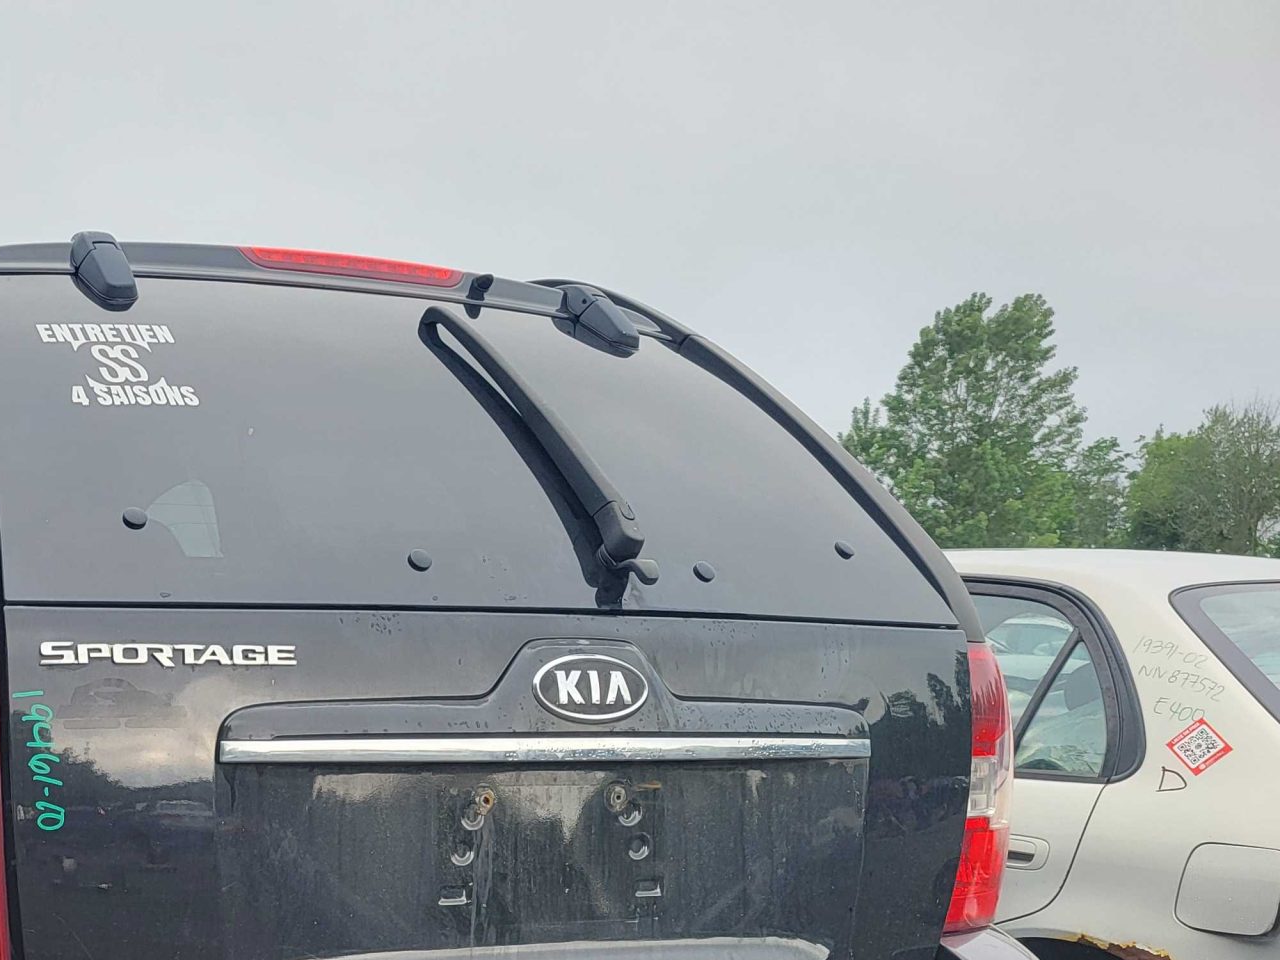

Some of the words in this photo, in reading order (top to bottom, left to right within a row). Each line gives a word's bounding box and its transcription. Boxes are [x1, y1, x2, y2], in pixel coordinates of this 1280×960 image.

[35, 323, 175, 352] ENTRETIEN
[72, 385, 89, 405] 4
[86, 376, 200, 406] SAISONS
[39, 641, 297, 668] SPORTAGE
[1133, 635, 1208, 669] 19391-02
[554, 670, 632, 705] KIA
[1167, 669, 1225, 702] 877572
[12, 689, 66, 832] 19461-10
[1156, 766, 1187, 792] D
